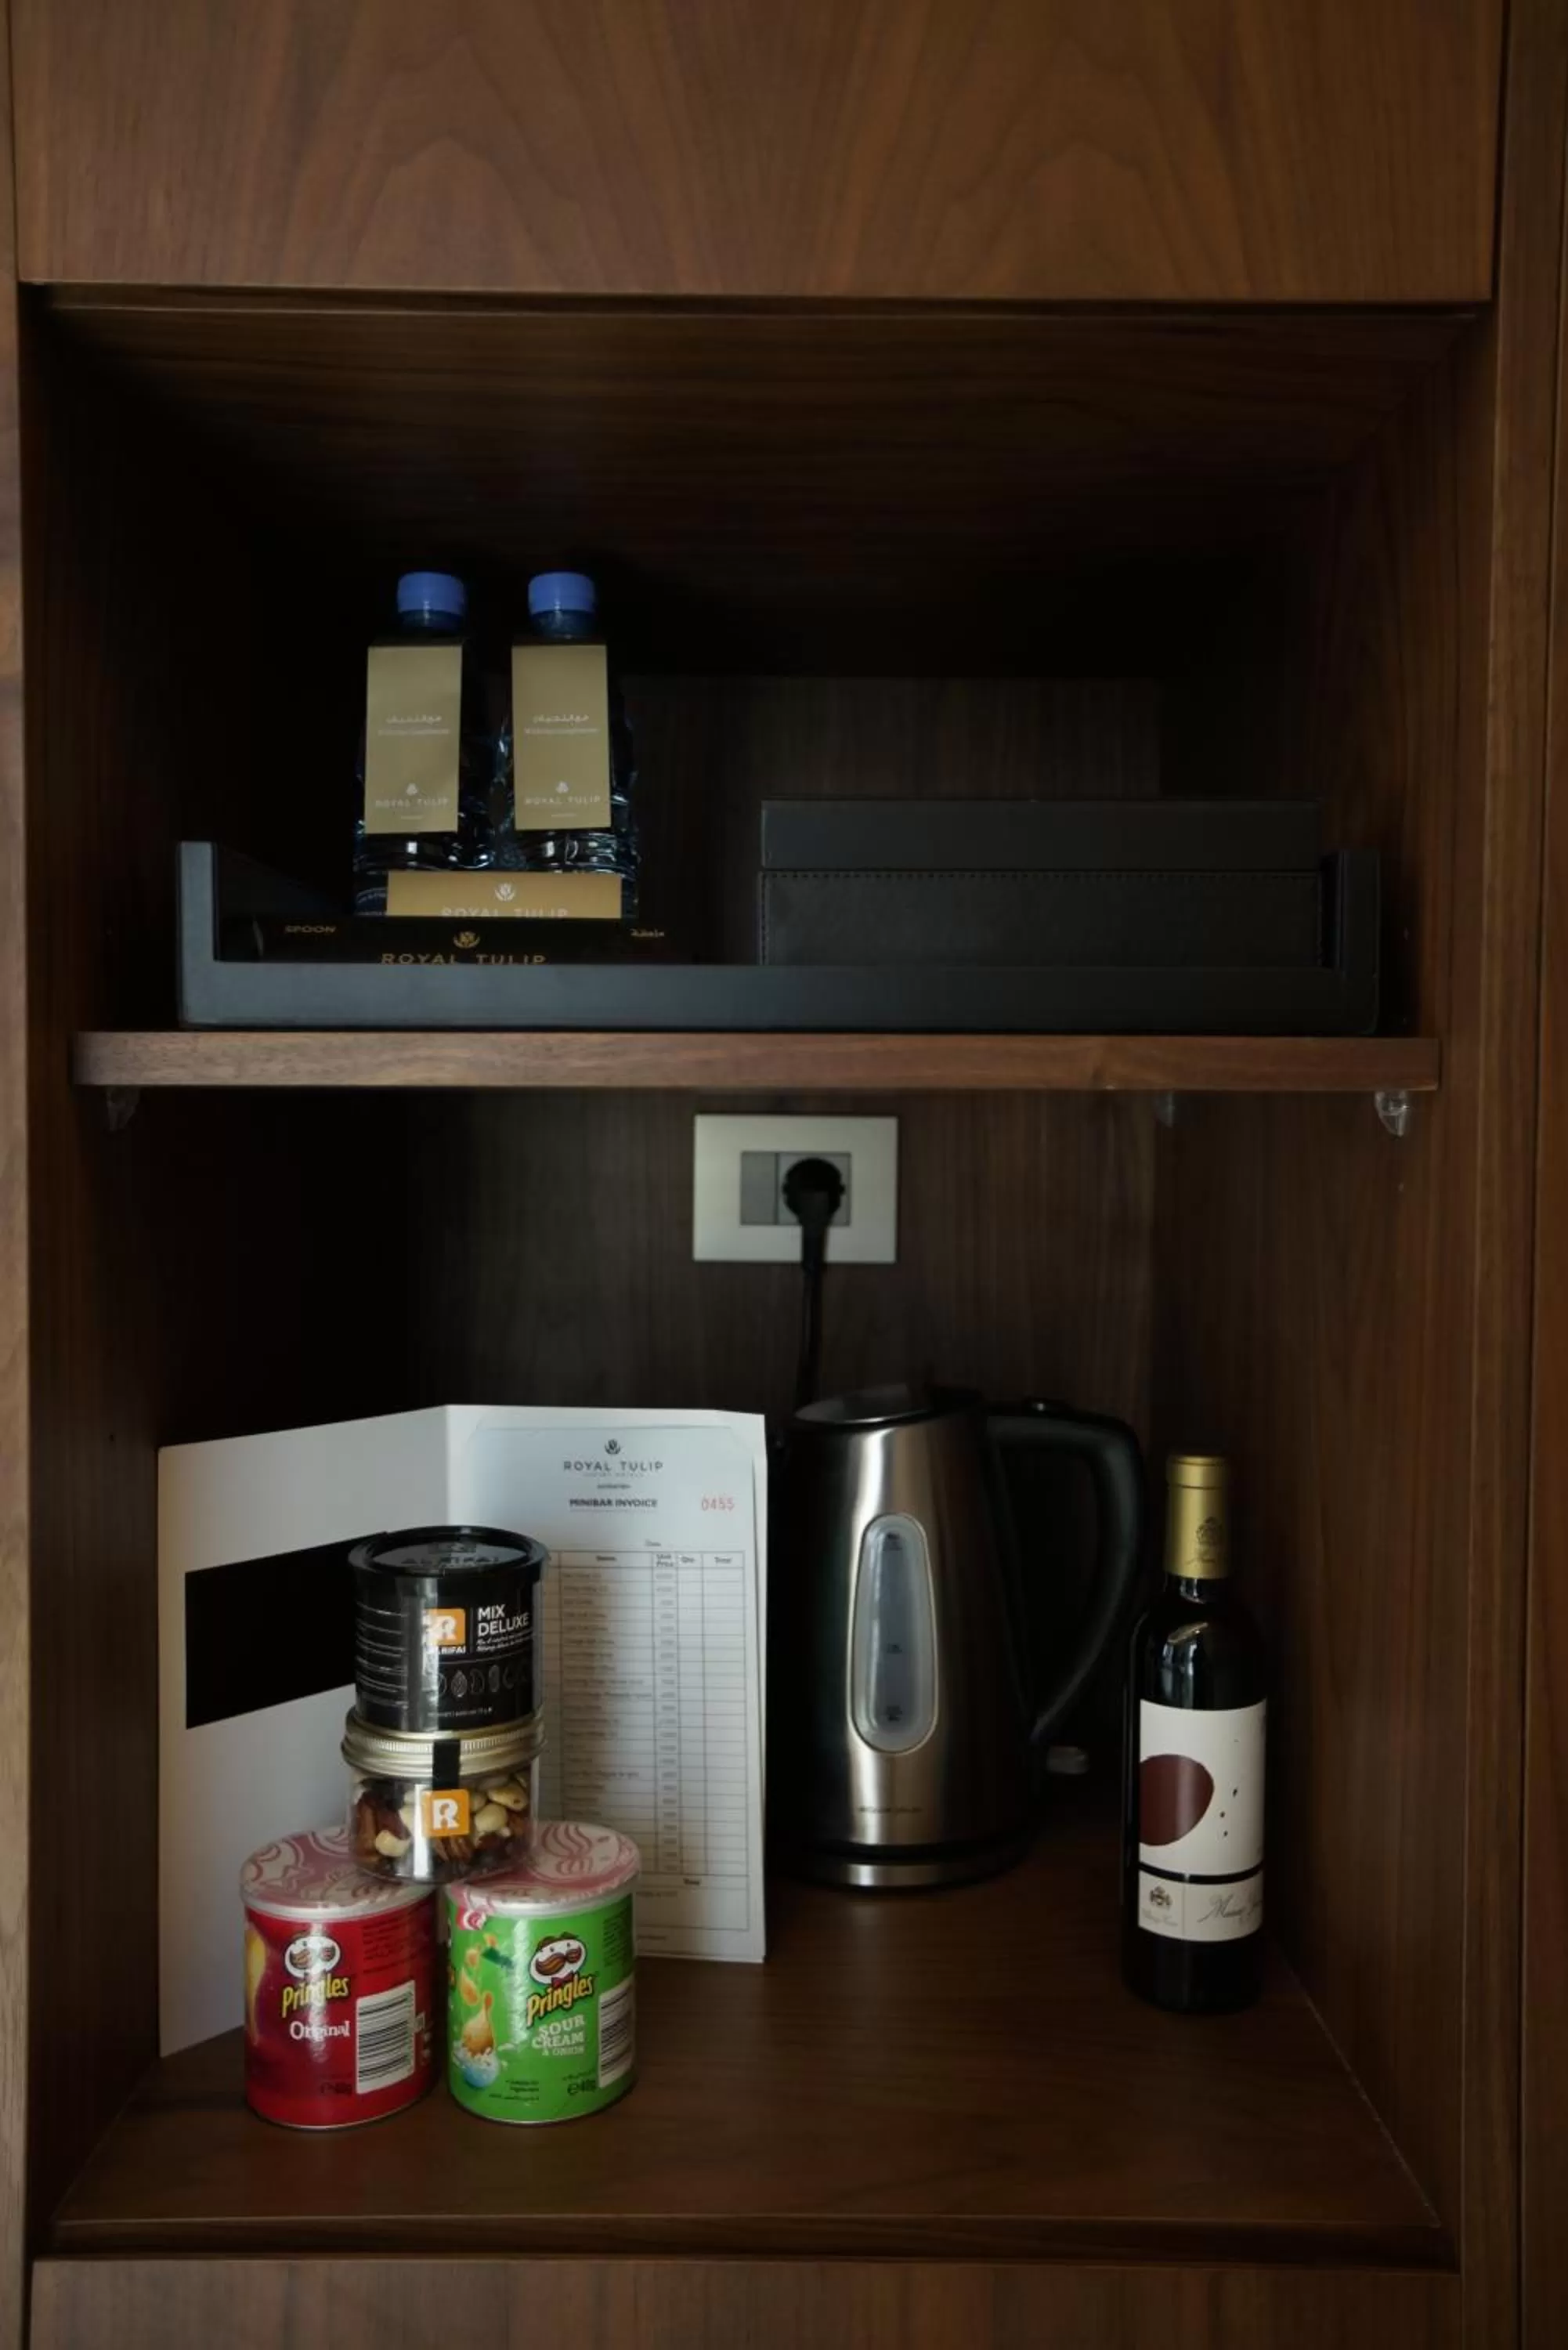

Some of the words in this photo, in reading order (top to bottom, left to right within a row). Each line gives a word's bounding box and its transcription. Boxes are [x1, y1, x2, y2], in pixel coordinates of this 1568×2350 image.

[380, 952, 460, 965] ROYAL
[475, 953, 547, 965] TULIP
[562, 1459, 612, 1472] ROYAL
[620, 1460, 663, 1472] TULIP
[569, 1498, 612, 1508] MINIBAR
[615, 1498, 658, 1508] INVOICE
[477, 1603, 507, 1621] MIX
[477, 1611, 530, 1637] DELUXE
[280, 1973, 350, 2019] Pringles
[526, 1972, 594, 2027] Pringles
[289, 2020, 351, 2041] Original
[538, 2013, 585, 2037] SOUR
[531, 2030, 585, 2048] CREAM
